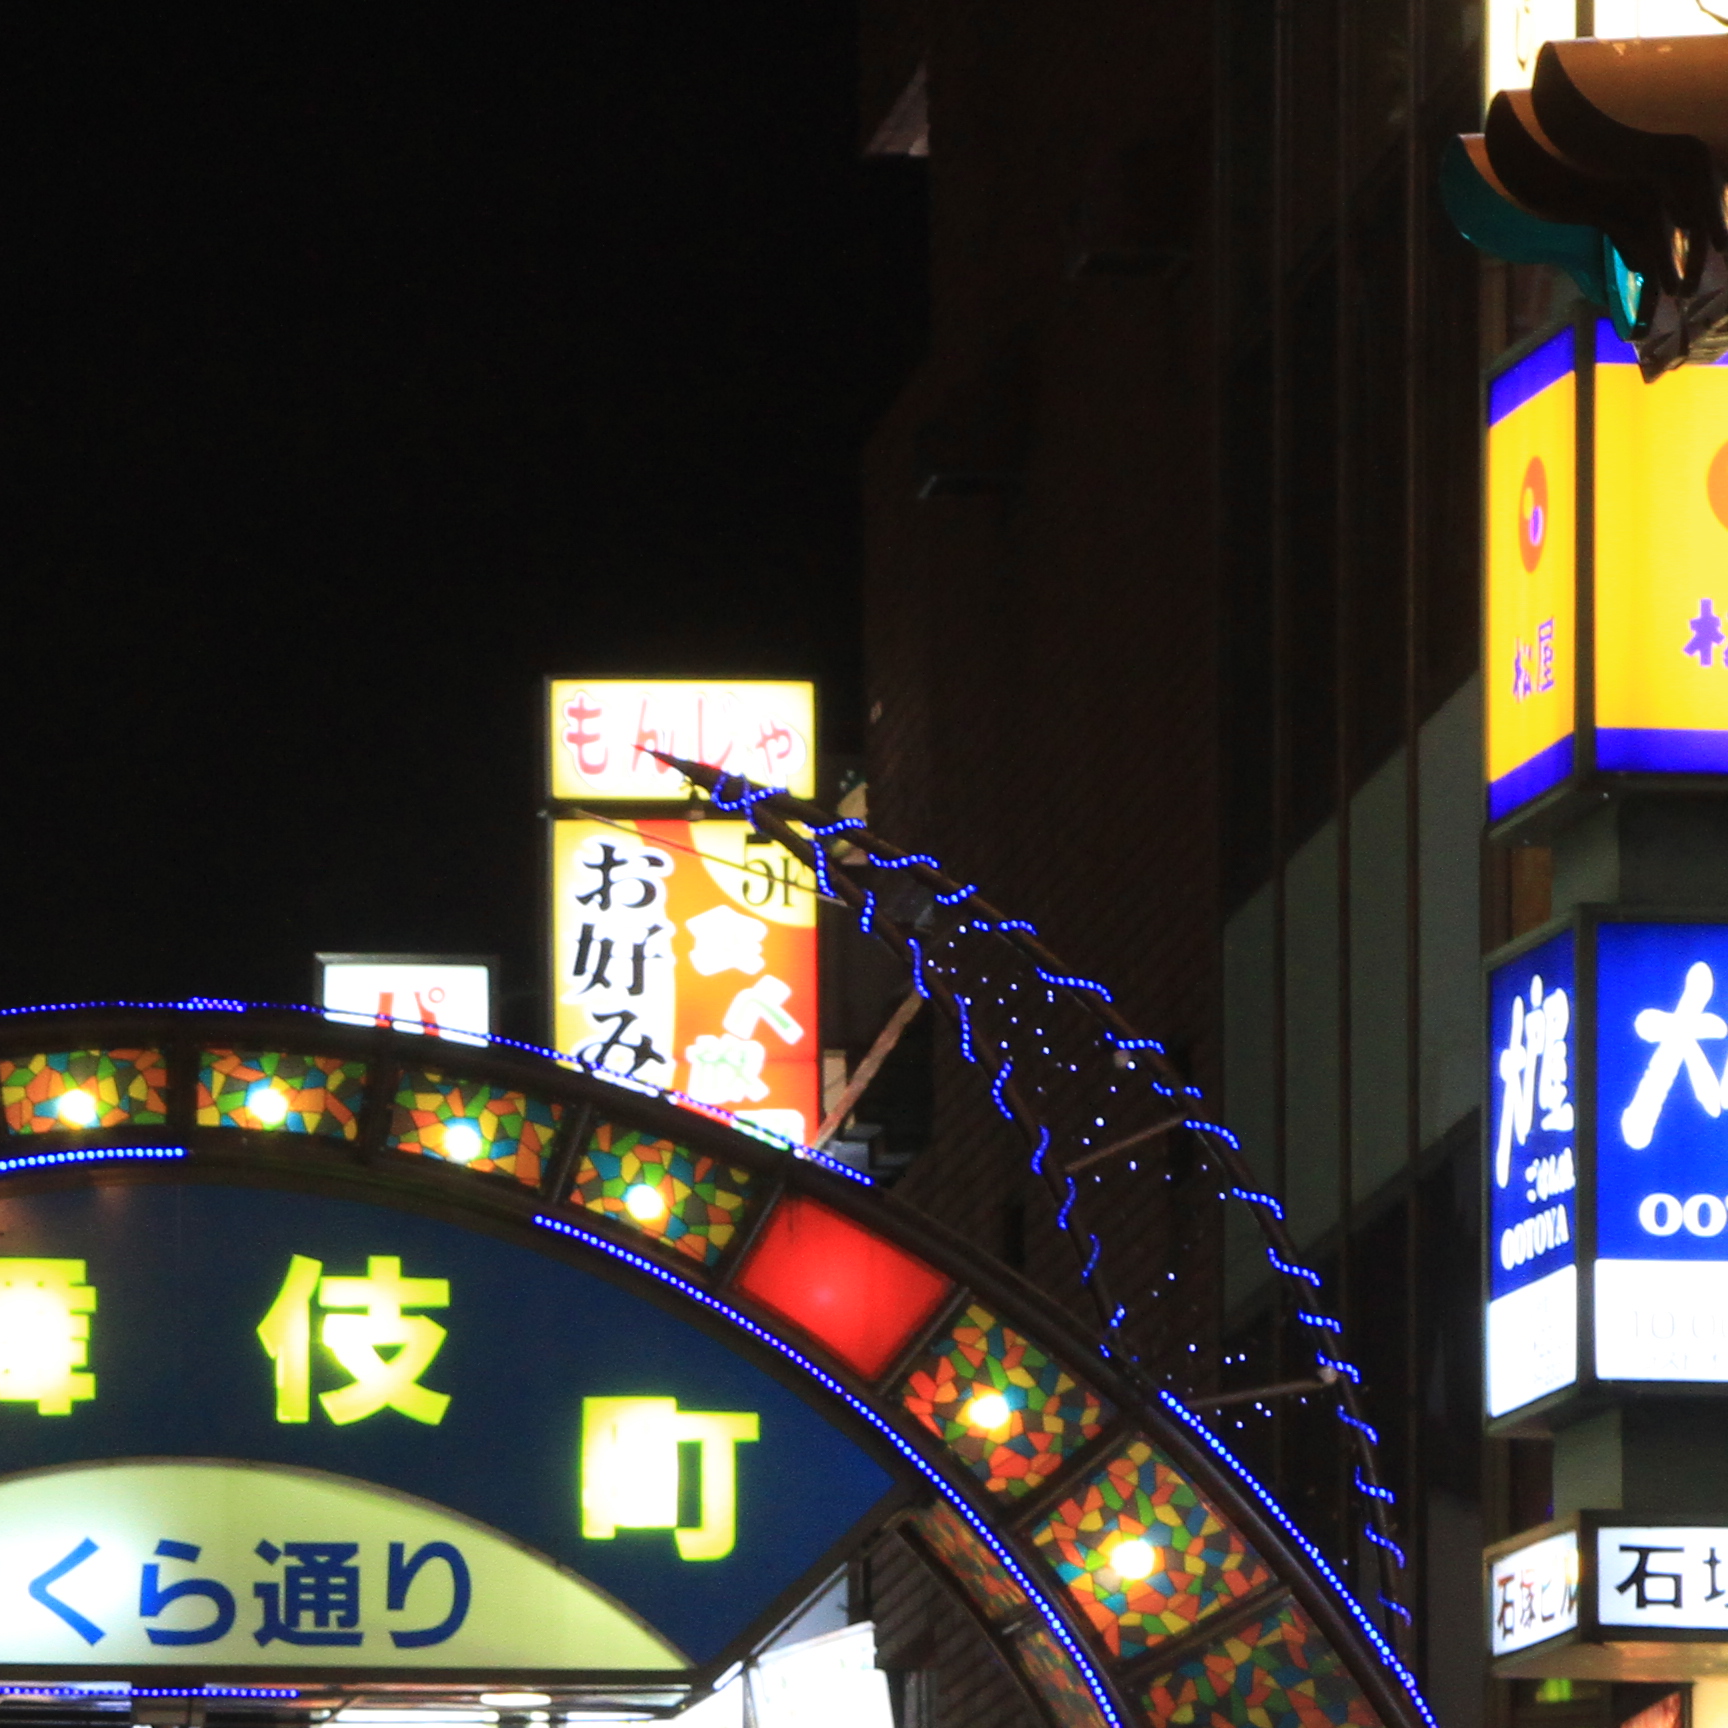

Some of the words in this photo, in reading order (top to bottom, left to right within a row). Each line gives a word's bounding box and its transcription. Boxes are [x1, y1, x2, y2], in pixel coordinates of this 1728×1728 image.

[564, 695, 796, 776] もんじゃ
[574, 840, 668, 1078] お好み
[1500, 1203, 1570, 1270] OOTOYA
[1638, 1192, 1728, 1237] OO
